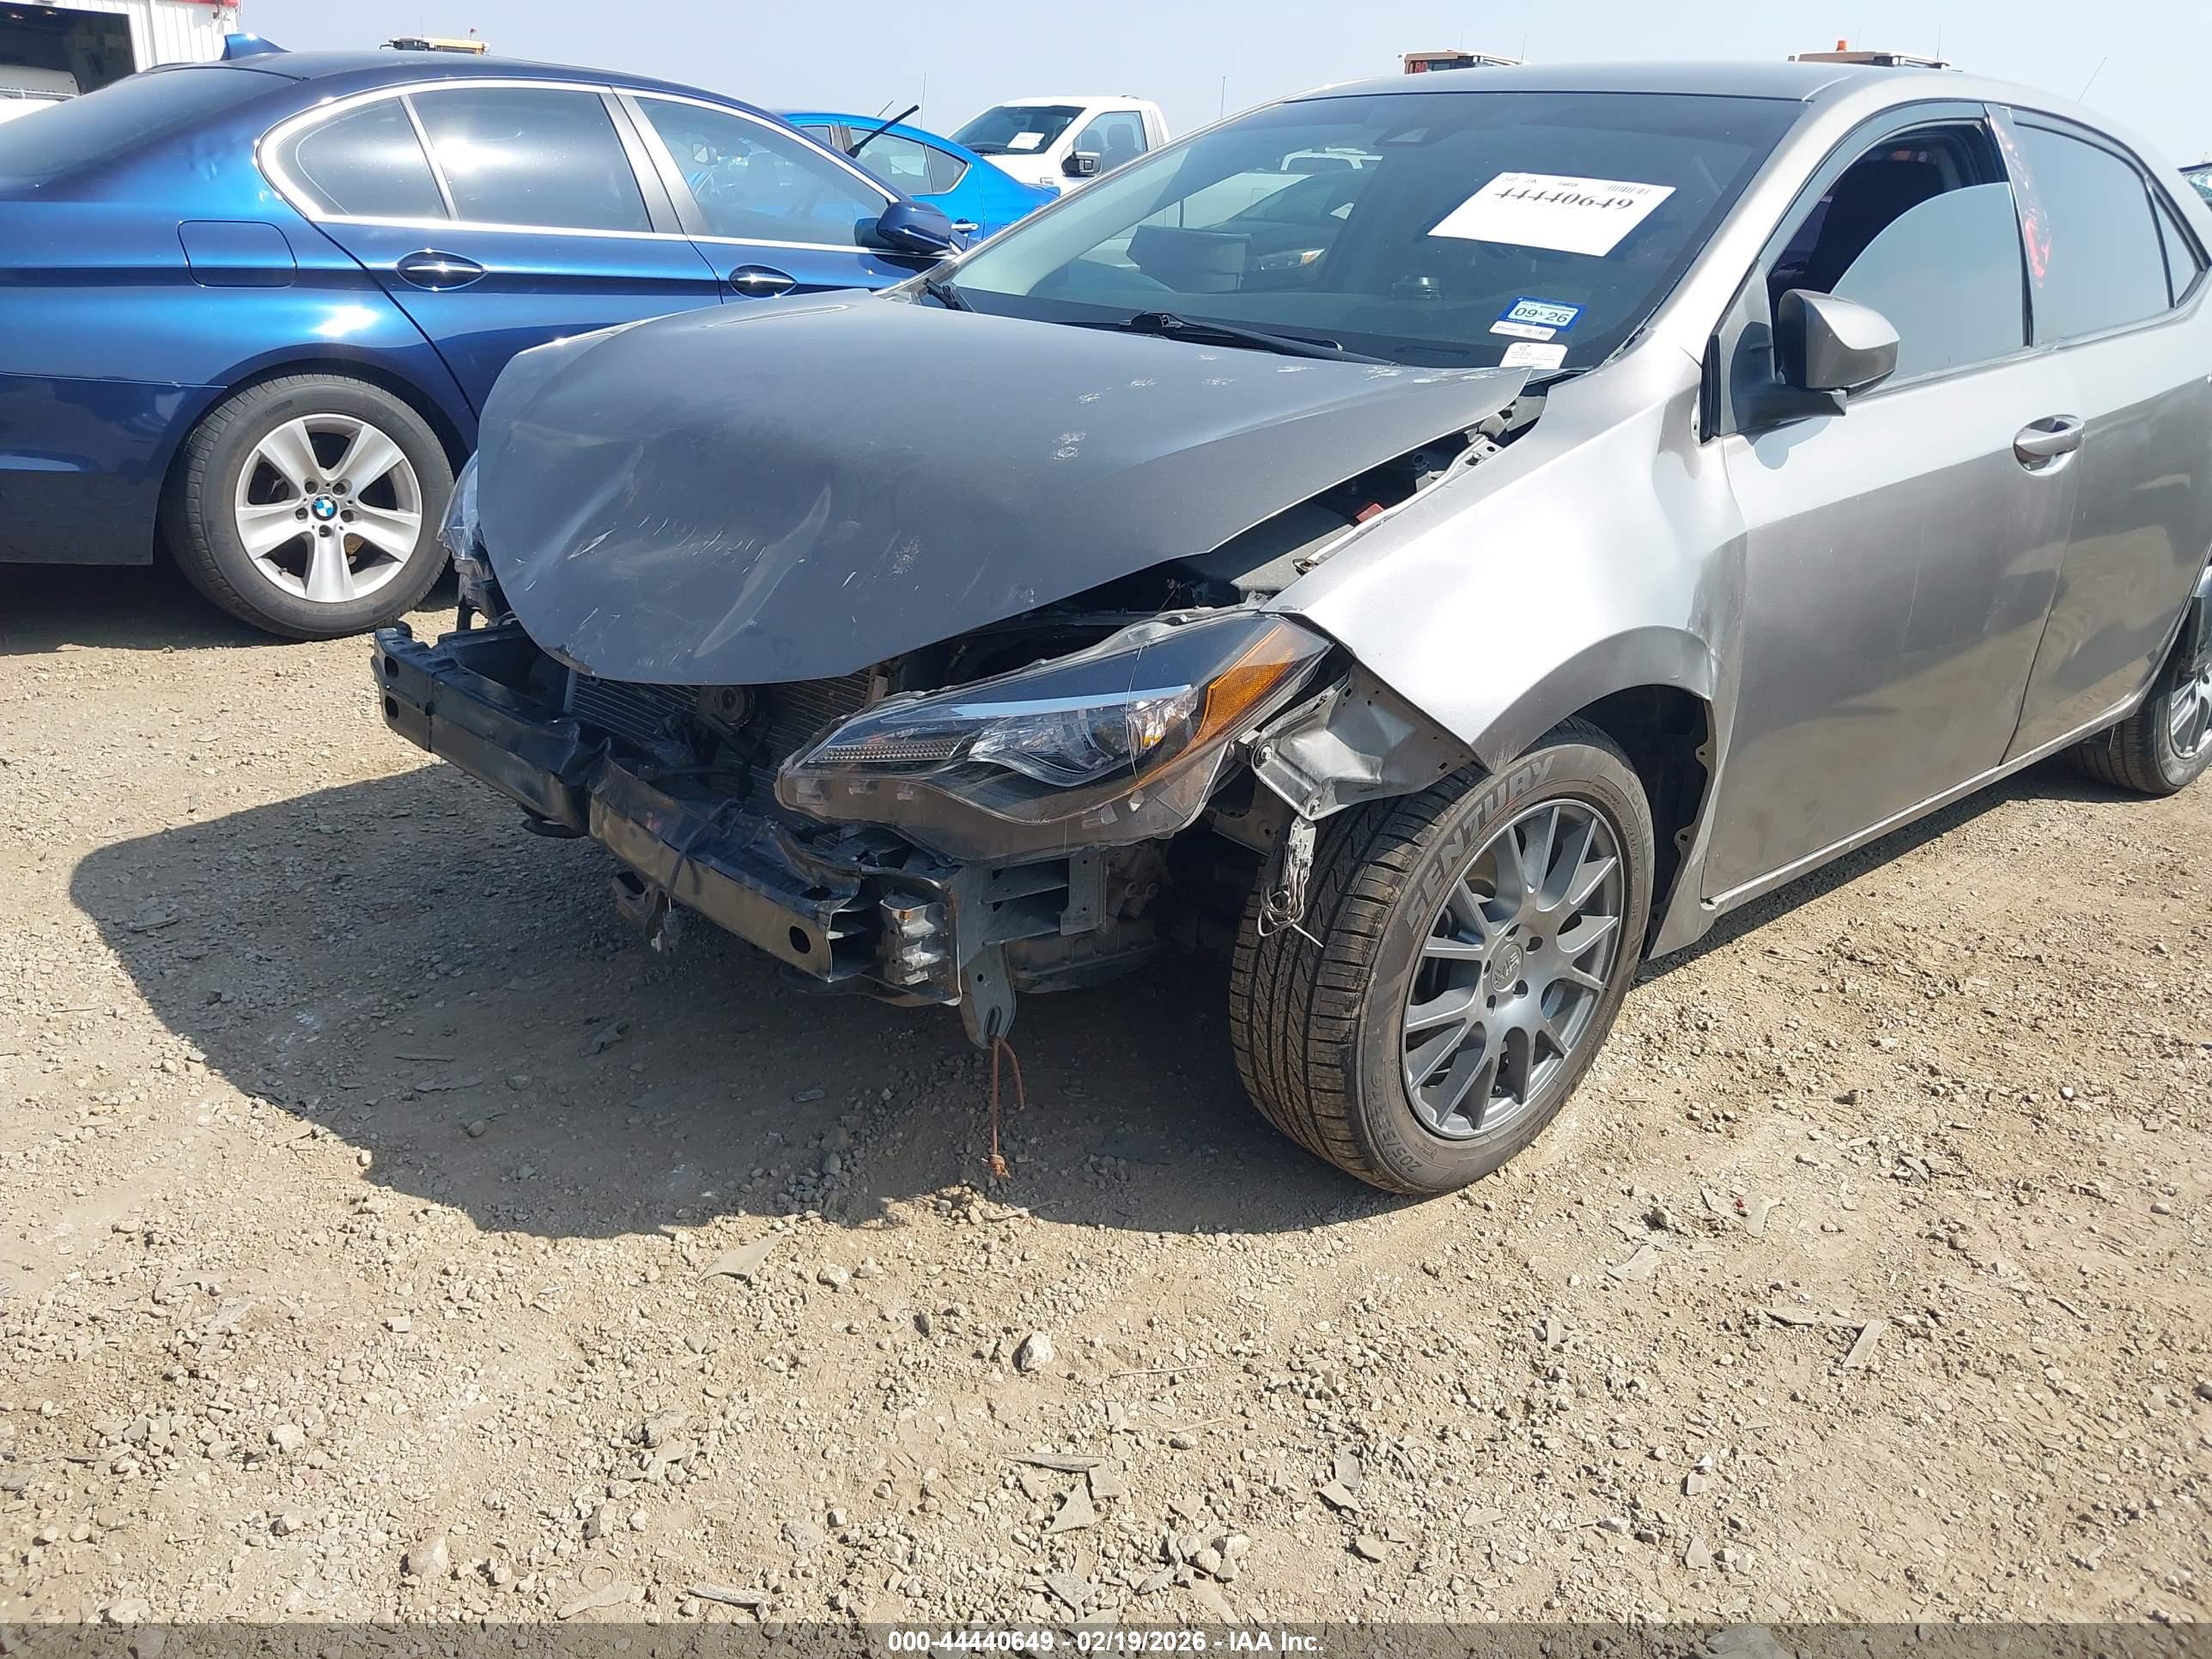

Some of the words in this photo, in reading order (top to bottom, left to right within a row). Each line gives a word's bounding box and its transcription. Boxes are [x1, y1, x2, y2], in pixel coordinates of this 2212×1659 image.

[1494, 187, 1634, 210] 44440649
[1514, 307, 1538, 318] 09
[1546, 312, 1571, 323] 26
[1405, 755, 1555, 937] SENTURY
